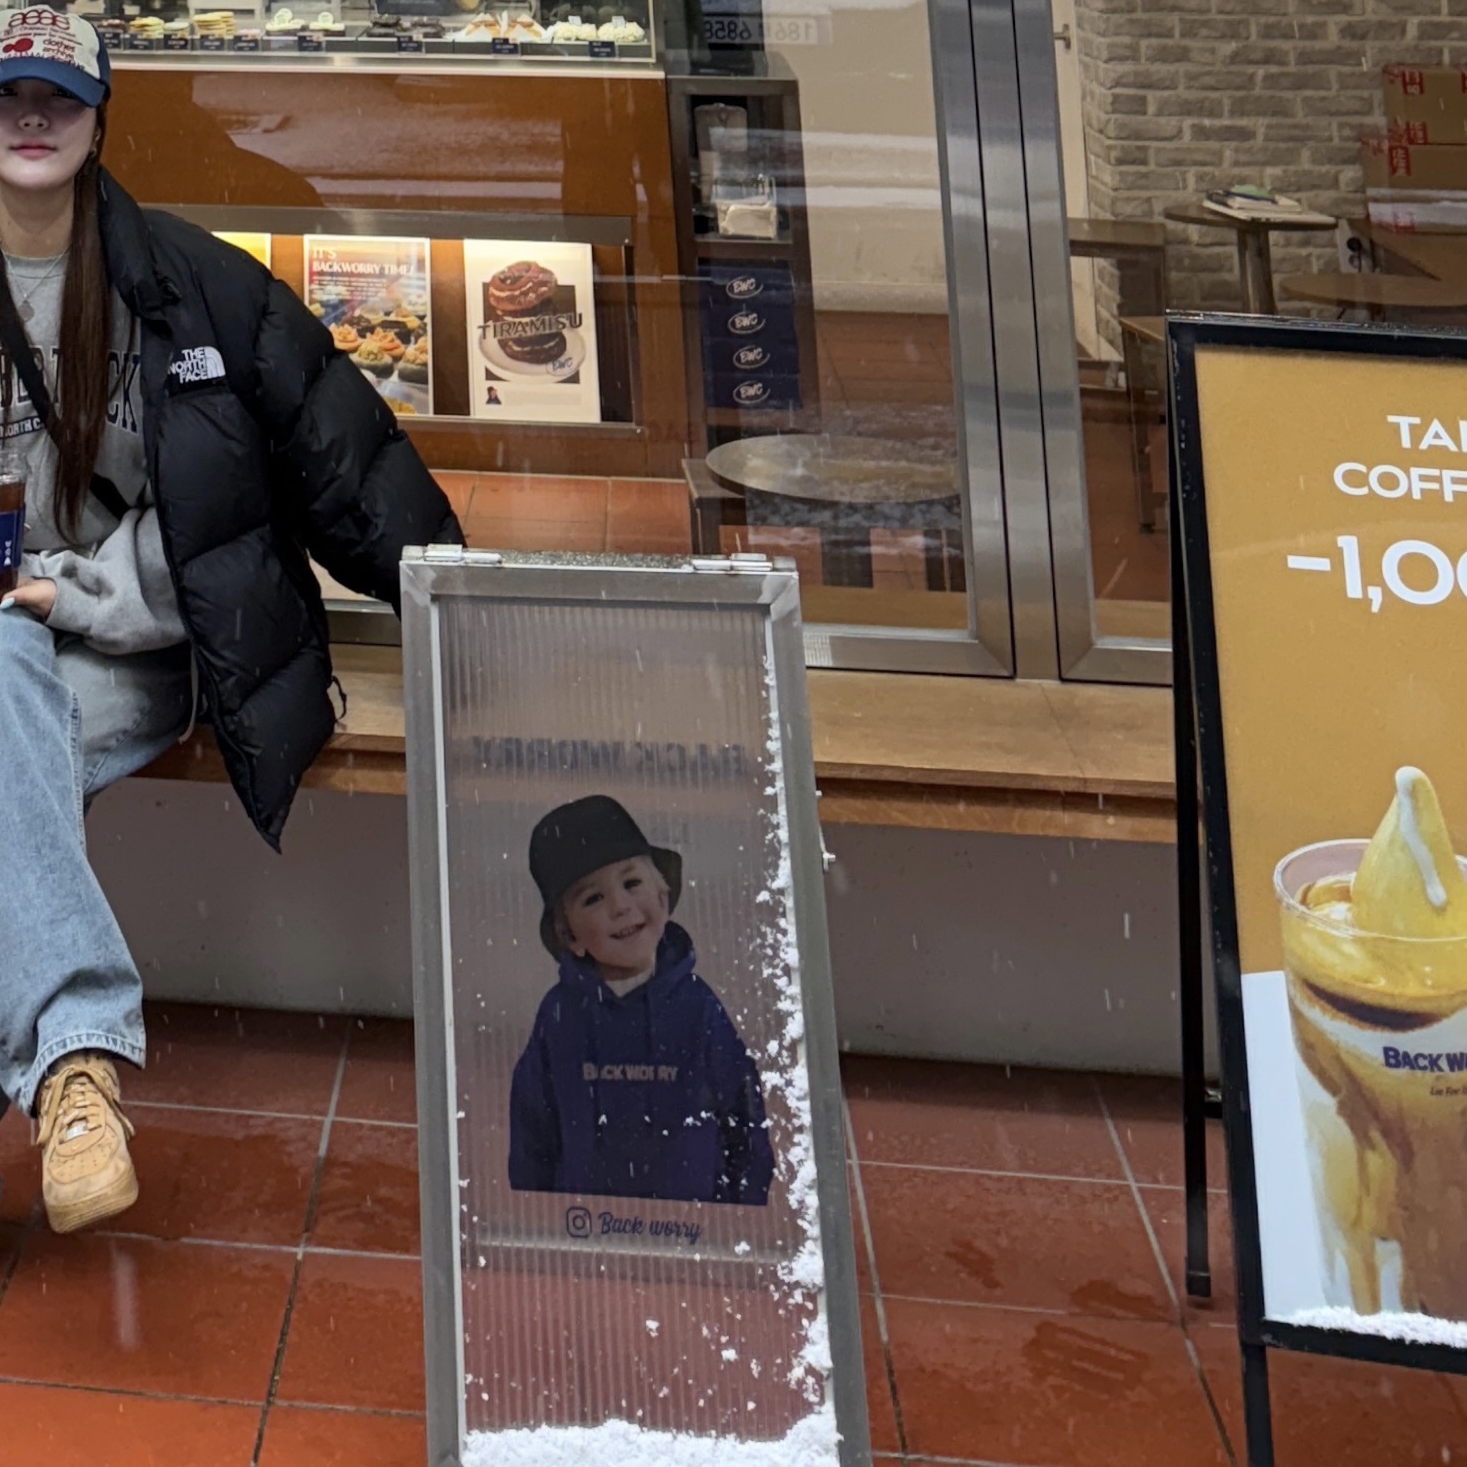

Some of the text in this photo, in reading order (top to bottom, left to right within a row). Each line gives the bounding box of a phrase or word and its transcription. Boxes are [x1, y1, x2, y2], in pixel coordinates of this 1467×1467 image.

[312, 261, 381, 274] BACKWORRY
[478, 313, 583, 340] TIRAMISU
[167, 358, 206, 375] NORTH
[181, 347, 205, 361] THE
[179, 369, 208, 384] FACE
[1387, 415, 1467, 452] TA
[1287, 535, 1467, 613] -1,0
[1382, 1046, 1467, 1073] BACK W
[598, 1212, 701, 1246] Back worry
